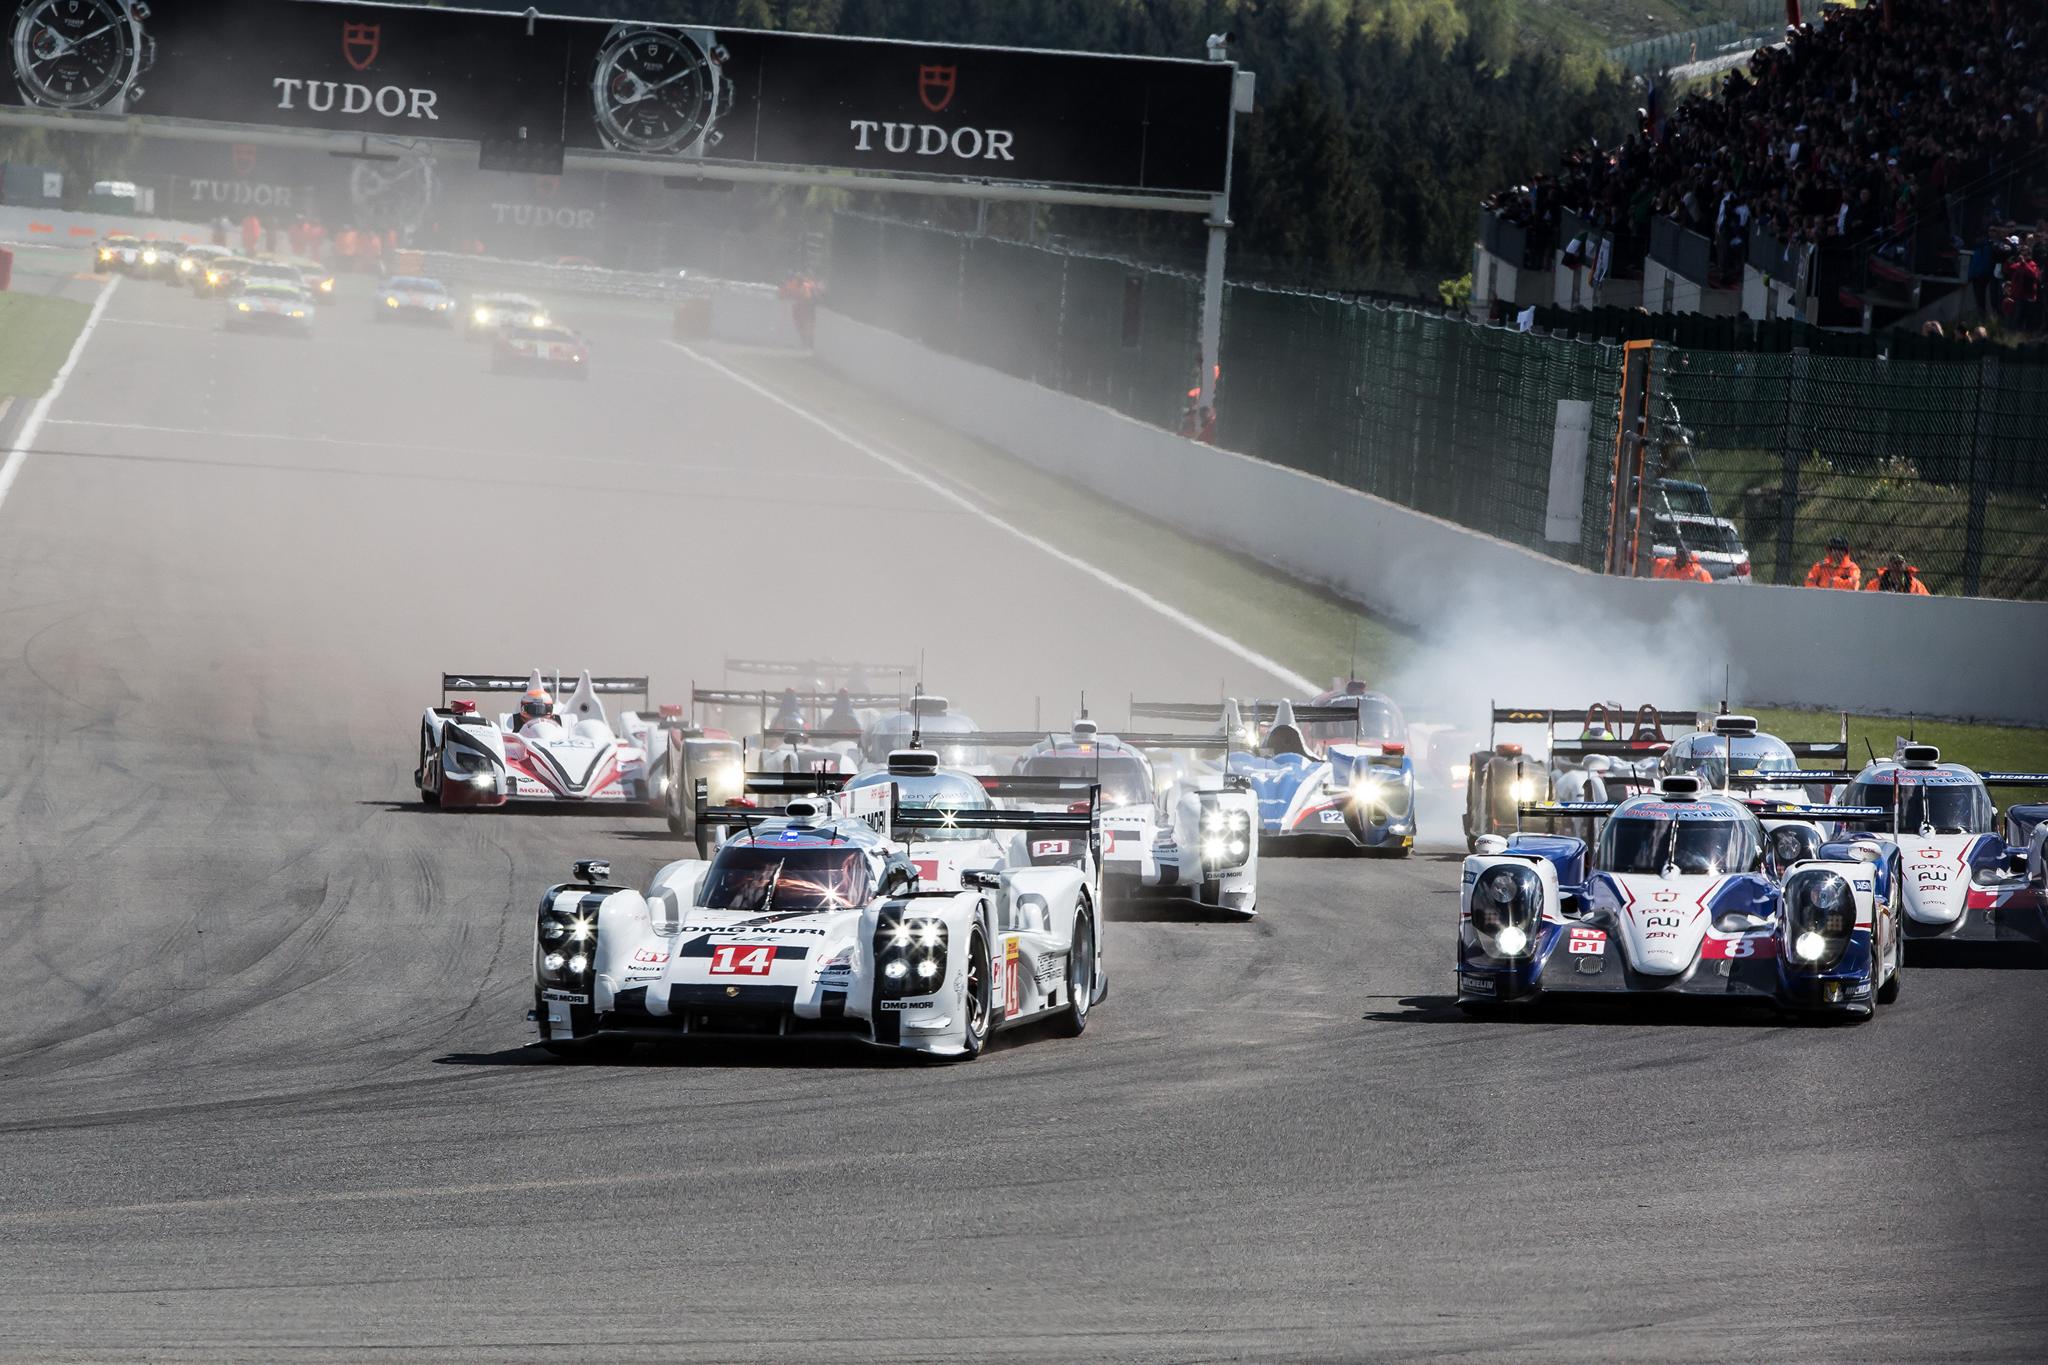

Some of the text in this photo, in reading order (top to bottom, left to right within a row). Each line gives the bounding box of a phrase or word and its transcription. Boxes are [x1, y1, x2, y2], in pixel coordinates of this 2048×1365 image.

[273, 77, 439, 120] TUDOR
[850, 120, 1015, 161] TUDOR
[190, 180, 292, 208] TUDOR
[491, 203, 595, 229] TUDOR
[1324, 813, 1344, 822] P2
[1039, 842, 1063, 854] P1
[1986, 891, 2014, 908] 7
[1640, 908, 1687, 916] TOTAL
[681, 926, 826, 937] DMG MORI
[1572, 929, 1605, 939] HY
[1573, 942, 1598, 952] P1
[1725, 940, 1755, 958] 8
[637, 950, 669, 963] HY
[712, 947, 769, 974] 14
[560, 994, 586, 1003] MORI
[882, 1001, 934, 1010] DMG MORI
